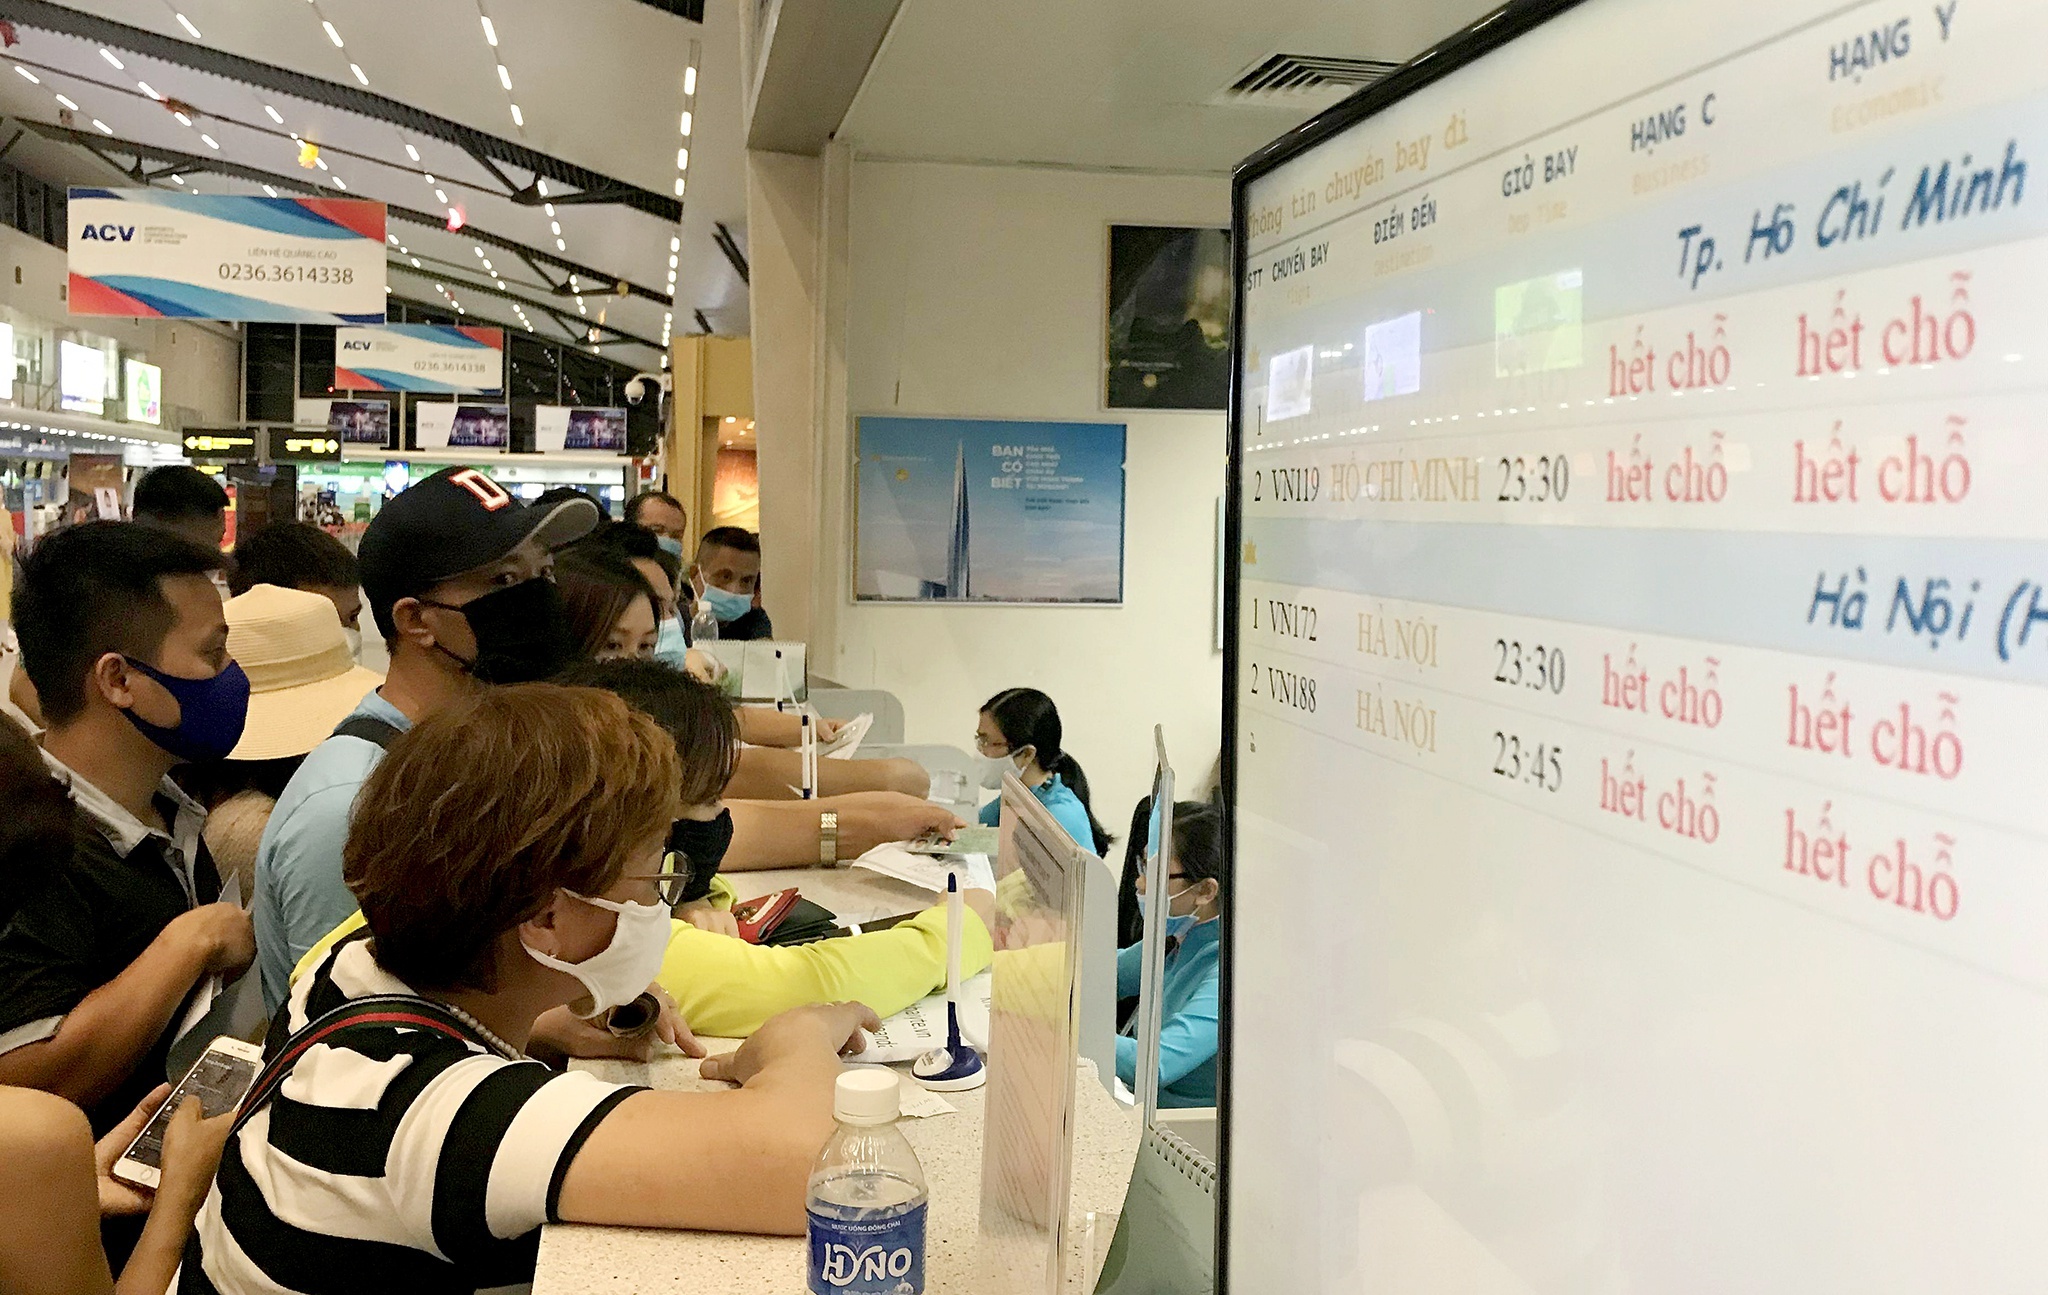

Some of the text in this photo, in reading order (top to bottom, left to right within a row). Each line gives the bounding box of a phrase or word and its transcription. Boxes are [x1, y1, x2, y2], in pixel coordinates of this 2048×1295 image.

[1829, 2, 1957, 83] HẠNG Y
[1291, 189, 1316, 219] tin
[1395, 134, 1431, 173] bay
[1443, 110, 1469, 150] đi
[1543, 146, 1579, 185] BAY
[1631, 93, 1716, 155] HẠNG C
[81, 224, 135, 243] ACV
[1678, 223, 1723, 291] Tp.
[1816, 167, 1897, 250] Chí
[1901, 139, 2030, 234] Minh
[218, 263, 354, 285] 0236.3614338
[1247, 269, 1263, 291] STT
[1311, 242, 1330, 268] BAY
[343, 341, 372, 351] ACV
[1609, 313, 1731, 397] hết chỗ
[1795, 271, 1977, 378] hết chỗ
[450, 469, 511, 512] D
[1254, 470, 1263, 503] 2
[1271, 466, 1320, 503] VN119
[1409, 456, 1481, 503] MINH
[1497, 455, 1570, 504] 23:30
[1605, 430, 1728, 503] hết chỗ
[1793, 414, 1972, 503] hết chỗ
[1252, 598, 1566, 696] 1 VN172 HÀ NỘI 23:30
[1807, 566, 1868, 631] Hà
[1886, 575, 1981, 651] Nội
[1602, 642, 1723, 729] hết chỗ
[1787, 671, 1964, 781] hết chỗ
[1251, 663, 1563, 793] 2 VN188 HÀ NỘI 23:45
[1600, 748, 1720, 845] hết chỗ
[1783, 800, 1960, 921] hết chỗ
